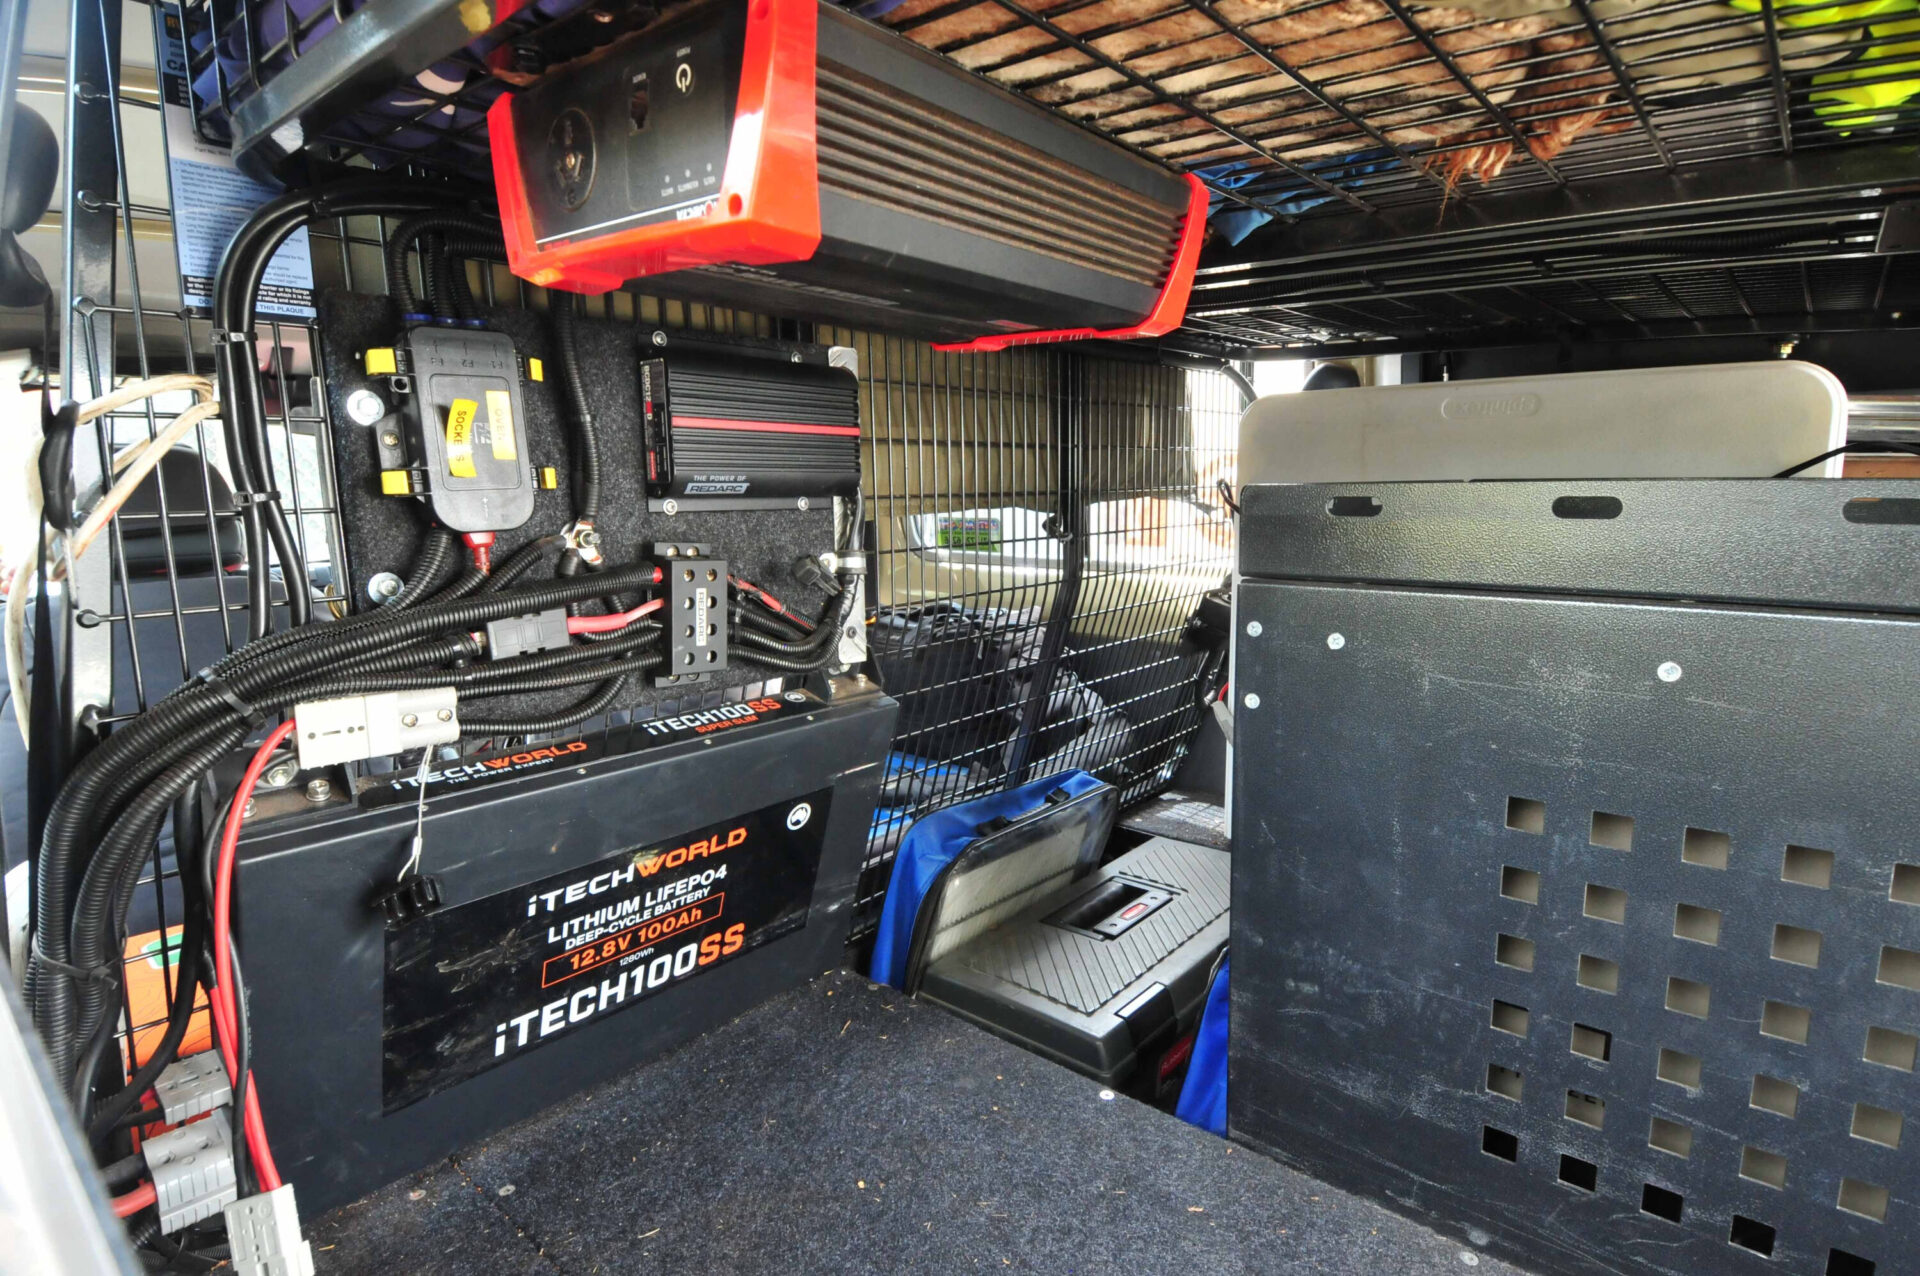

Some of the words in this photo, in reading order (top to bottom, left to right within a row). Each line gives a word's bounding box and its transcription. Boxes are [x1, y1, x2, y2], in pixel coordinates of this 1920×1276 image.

[277, 306, 305, 314] PLAQUE
[453, 410, 467, 462] SOCKES
[688, 483, 744, 493] REDARC
[642, 698, 782, 736] iTECH100SS
[695, 720, 733, 733] SUPER
[733, 714, 760, 726] SLIM
[447, 775, 471, 785] THE
[473, 767, 513, 780] POWER
[514, 757, 556, 771] EXPERT
[547, 895, 640, 944] LITHIUM
[645, 864, 728, 908] LIFEPO4
[565, 909, 652, 950] DEEP-CYCLE
[654, 886, 712, 916] BATTERY
[570, 932, 633, 970] 12.8V
[638, 906, 702, 943] 100Ah
[619, 947, 655, 967] 1280Wh
[494, 923, 745, 1057] iTECH100SS
